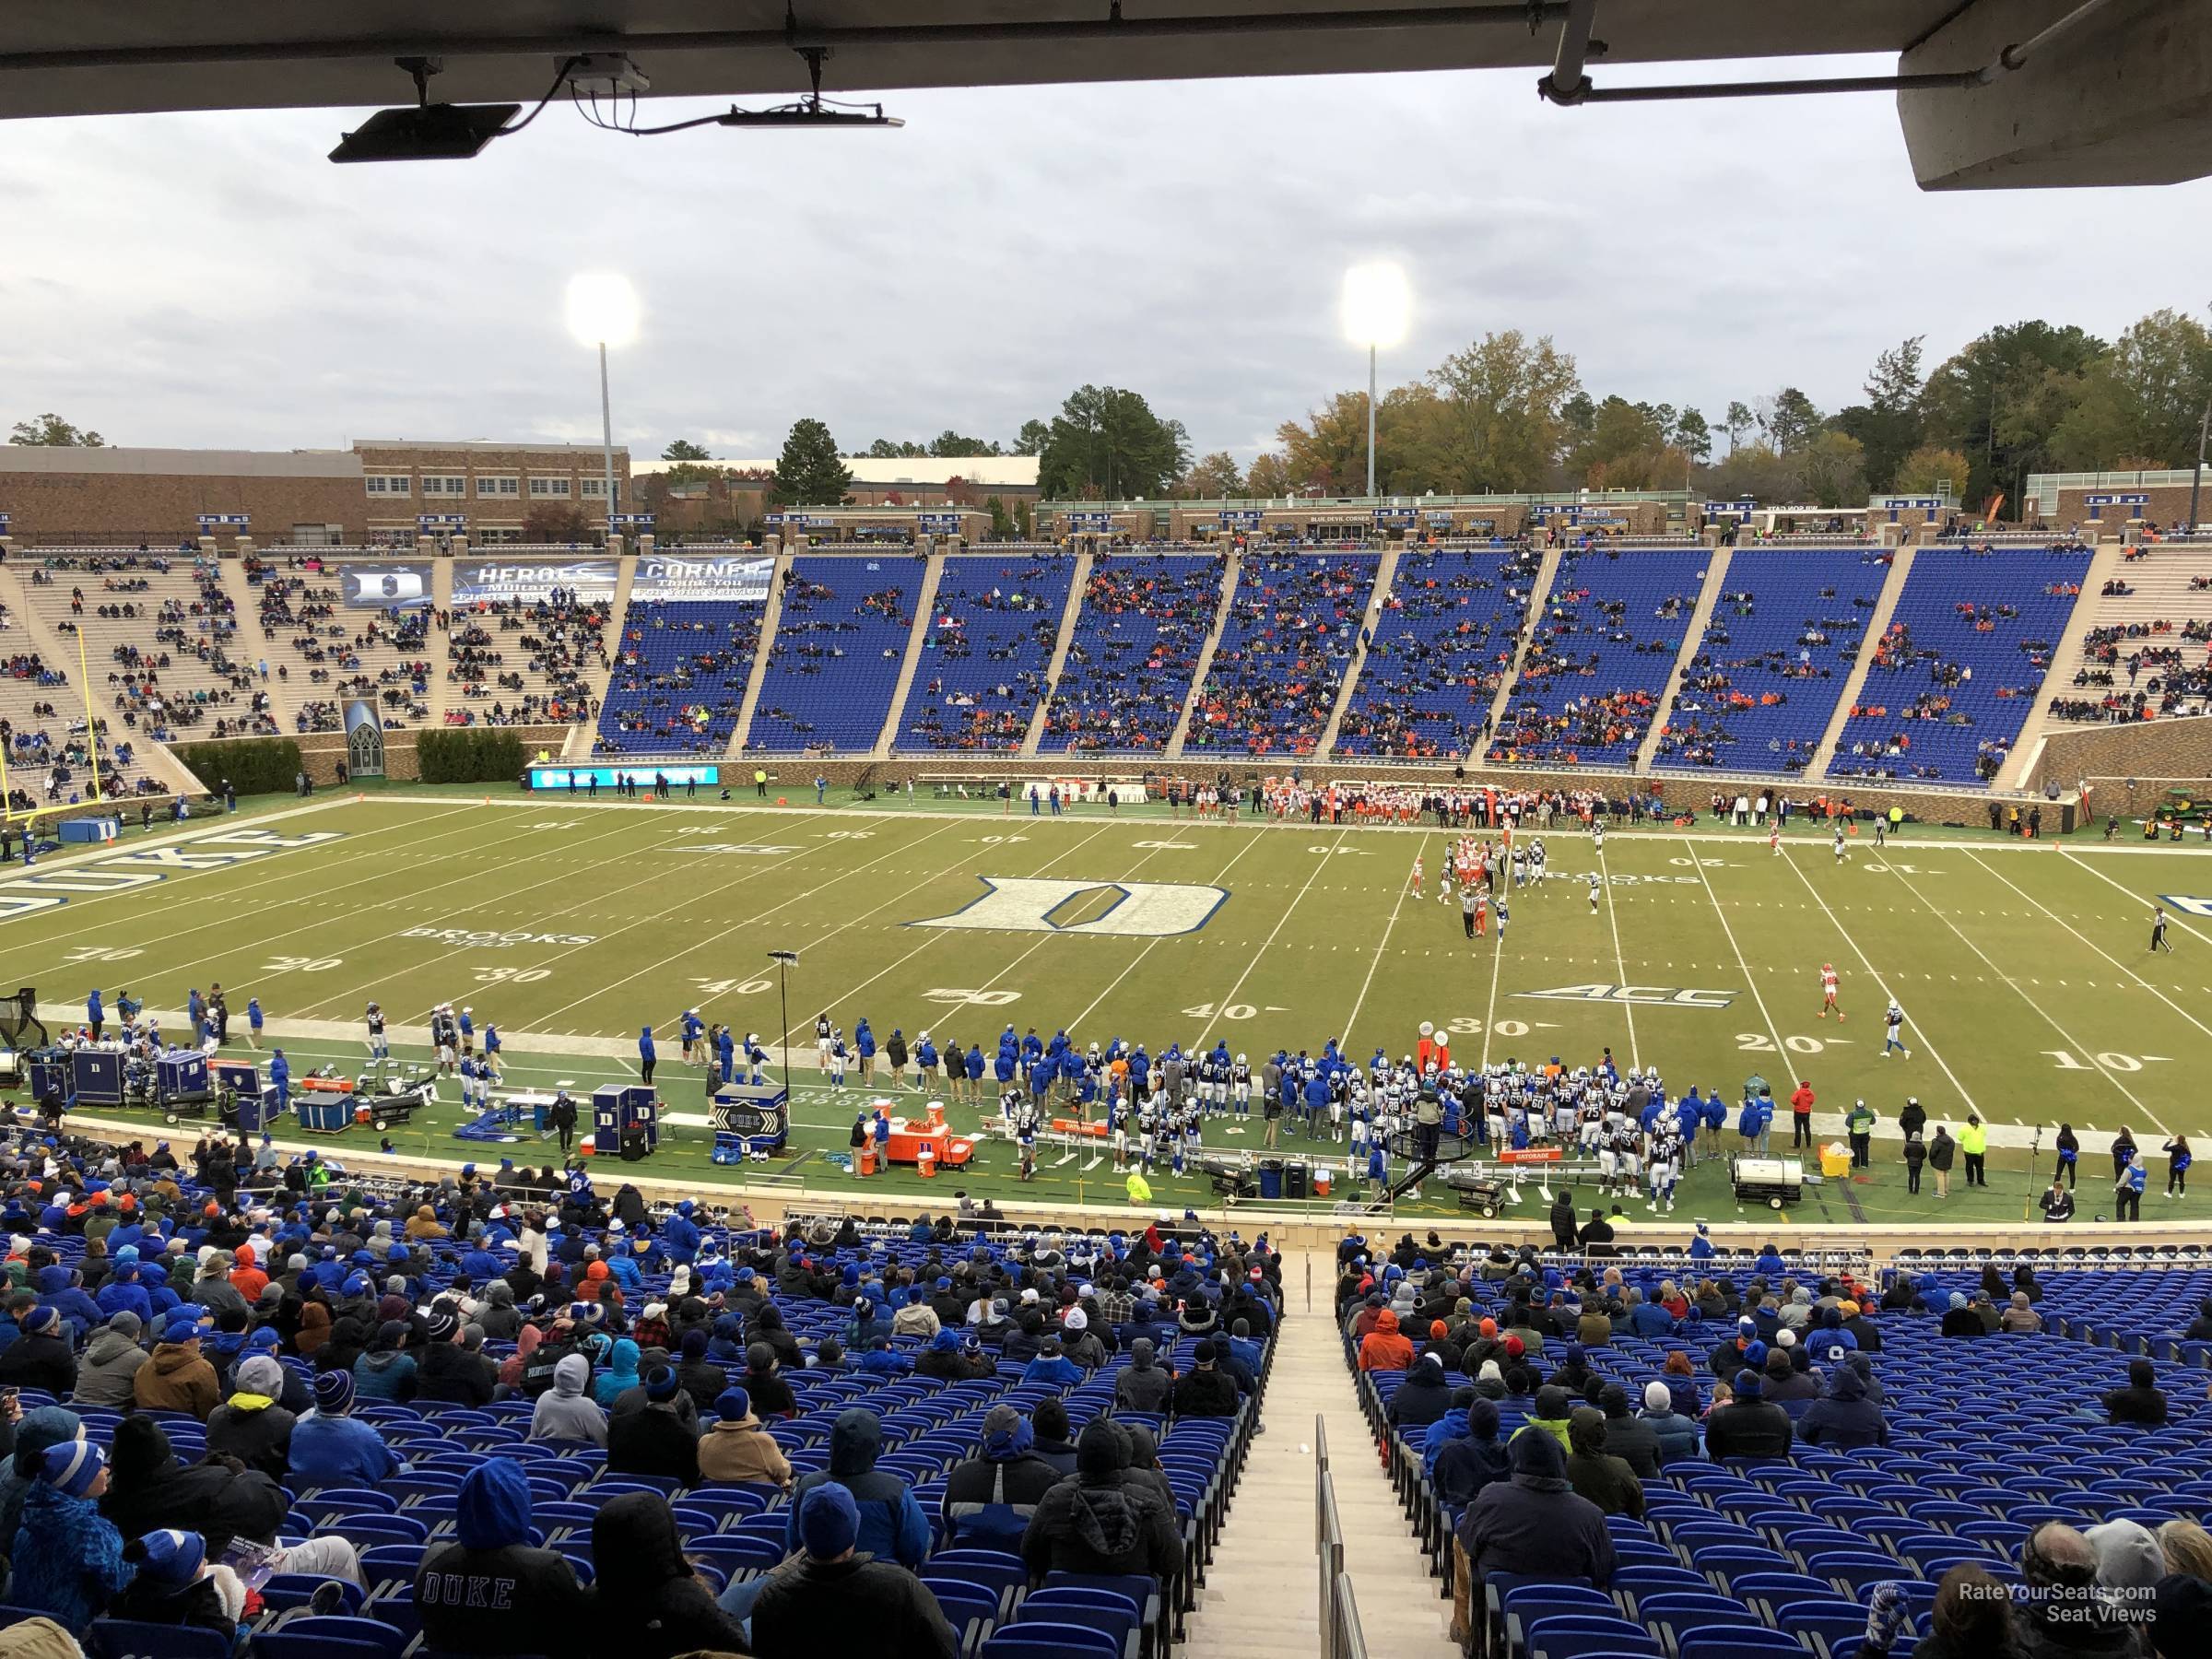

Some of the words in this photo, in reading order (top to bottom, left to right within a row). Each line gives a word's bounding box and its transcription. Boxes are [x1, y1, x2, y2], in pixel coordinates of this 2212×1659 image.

[477, 567, 593, 583] HEROES
[646, 563, 761, 579] CORNER
[897, 876, 1231, 937] D
[397, 928, 597, 945] BROOKS
[441, 939, 515, 947] FIELD
[63, 947, 147, 961] 10
[260, 956, 343, 971] 20
[474, 967, 552, 983] 30
[697, 978, 773, 994] 40
[921, 988, 1022, 1006] 50
[1504, 984, 1742, 1008] ACC
[1181, 1003, 1257, 1019] 40
[1446, 1017, 1530, 1037] 30
[1734, 1033, 1824, 1053] 20
[2040, 1050, 2145, 1072] 10
[1204, 1065, 1212, 1077] 91
[1235, 1068, 1245, 1077] 34
[1376, 1072, 1388, 1082] 56
[1487, 1099, 1499, 1108] 55
[1510, 1095, 1523, 1105] 69
[1531, 1099, 1544, 1109] 60
[1559, 1092, 1571, 1103] 79
[1610, 1097, 1623, 1107] 67
[599, 1112, 613, 1125] D
[636, 1107, 651, 1120] D
[1586, 1106, 1599, 1118] 75
[730, 1113, 760, 1126] DUKE
[1019, 1115, 1030, 1129] 15
[1140, 1119, 1150, 1129] 36
[422, 1571, 516, 1609] DUKE
